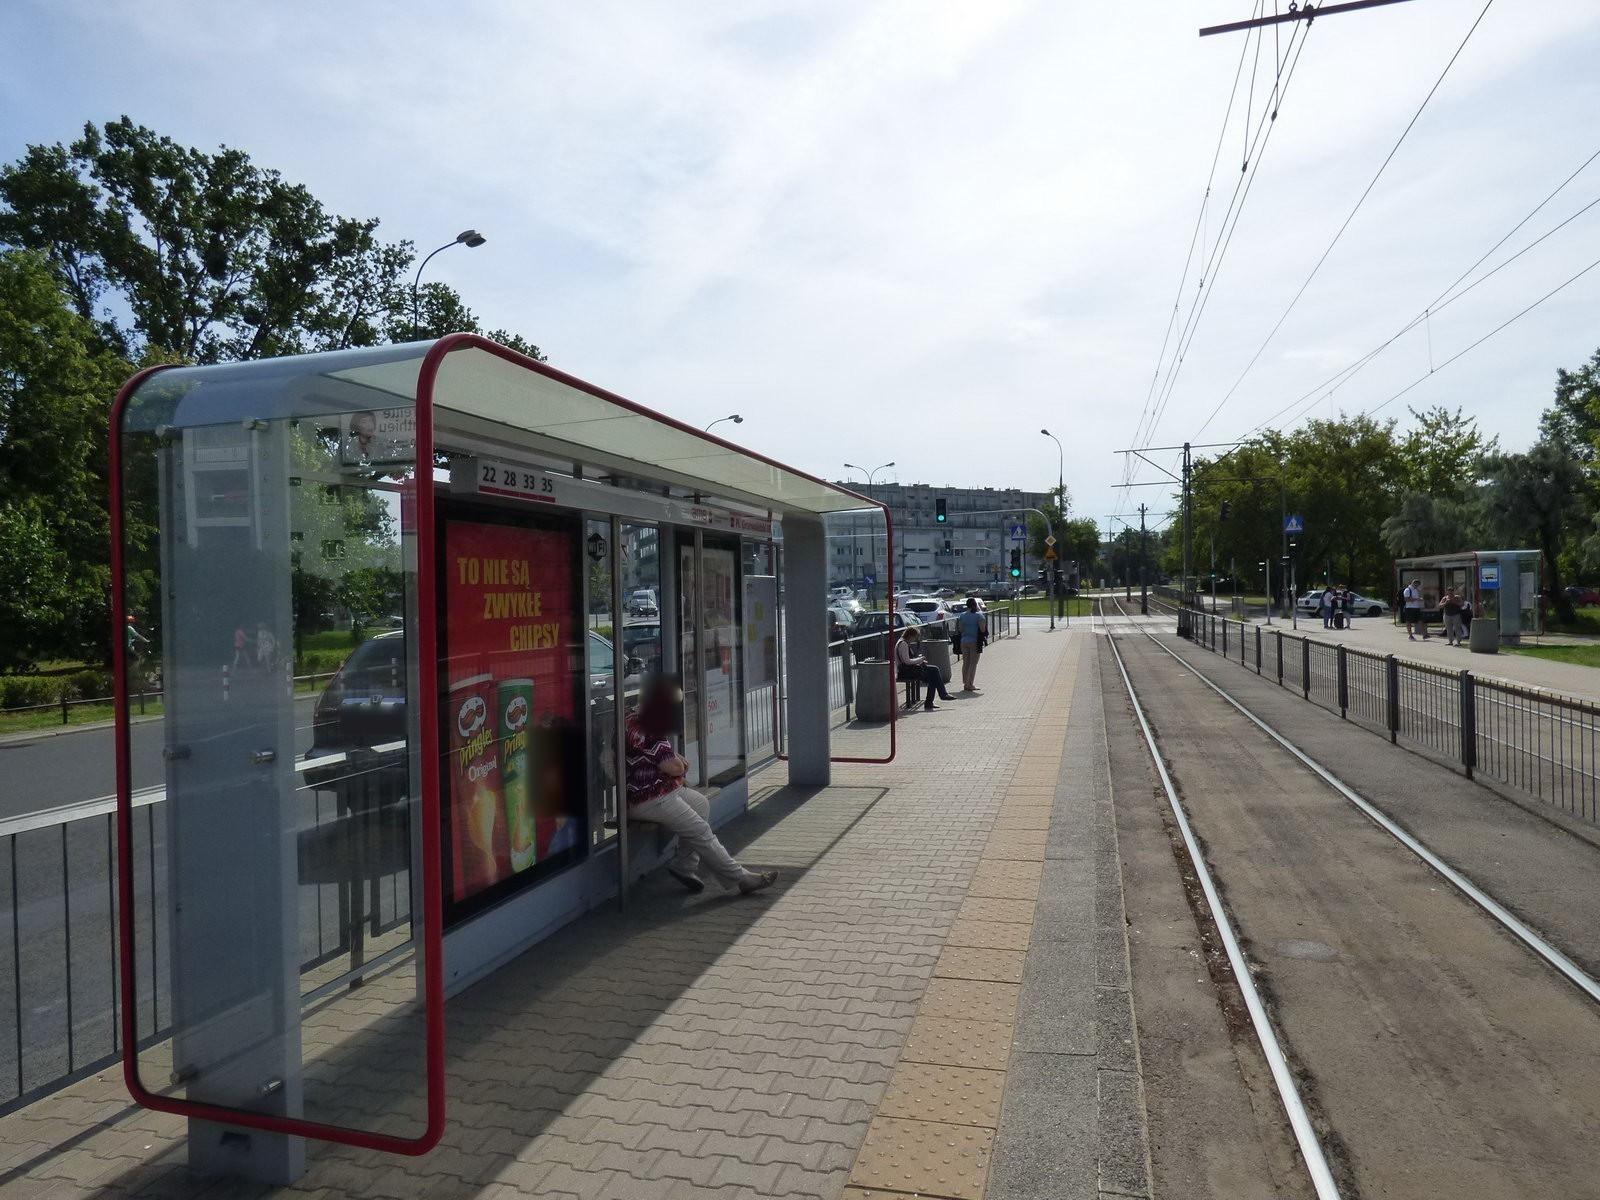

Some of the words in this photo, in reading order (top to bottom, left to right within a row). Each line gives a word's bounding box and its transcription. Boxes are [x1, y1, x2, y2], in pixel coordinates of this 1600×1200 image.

[482, 466, 496, 483] 22
[504, 470, 517, 487] 28
[523, 474, 535, 490] 33
[541, 477, 553, 493] 35
[457, 557, 480, 585] TO
[483, 558, 510, 585] NIE
[511, 559, 530, 589] SĄ
[483, 592, 542, 620] ZWYKŁE
[510, 623, 560, 652] CHIPSY
[459, 726, 493, 776] Pringles
[468, 755, 497, 781] Original
